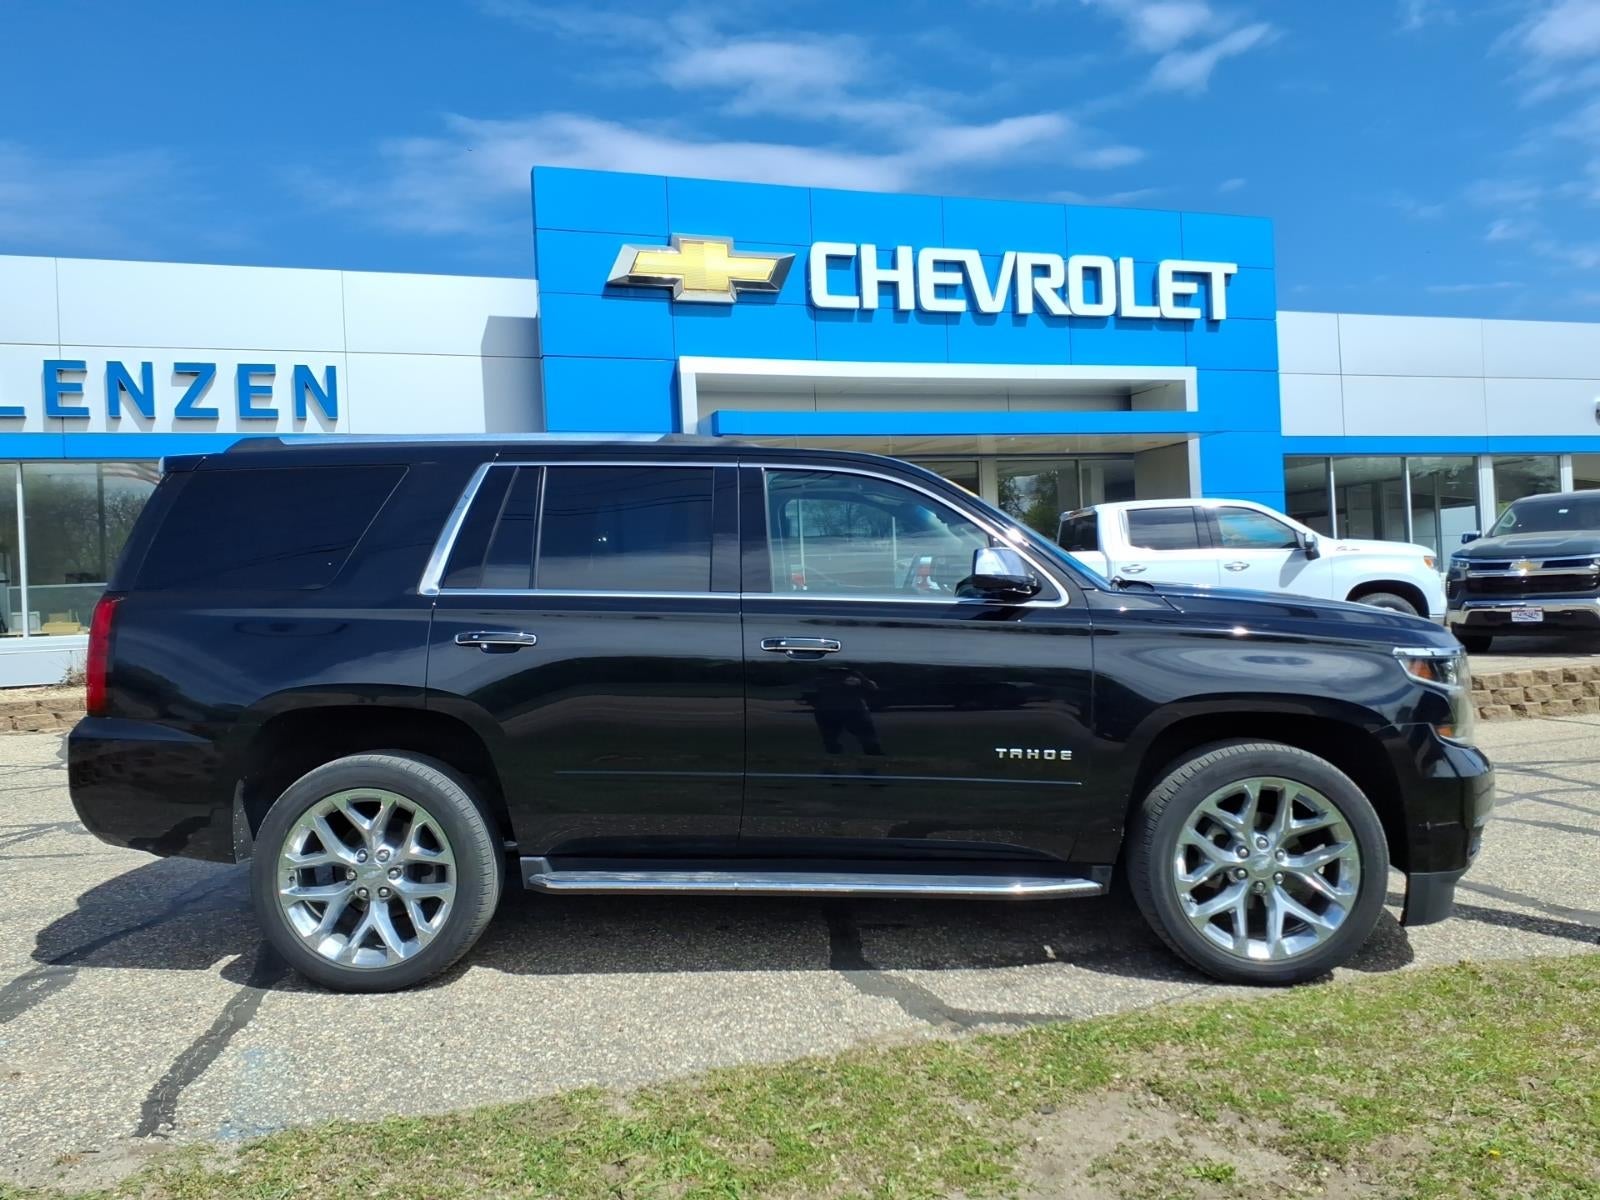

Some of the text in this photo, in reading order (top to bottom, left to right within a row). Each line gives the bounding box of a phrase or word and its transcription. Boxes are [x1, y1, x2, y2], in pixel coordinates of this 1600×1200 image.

[808, 241, 1238, 321] CHEVROLET
[0, 360, 338, 420] ENZEN
[995, 748, 1073, 761] TAHOE
